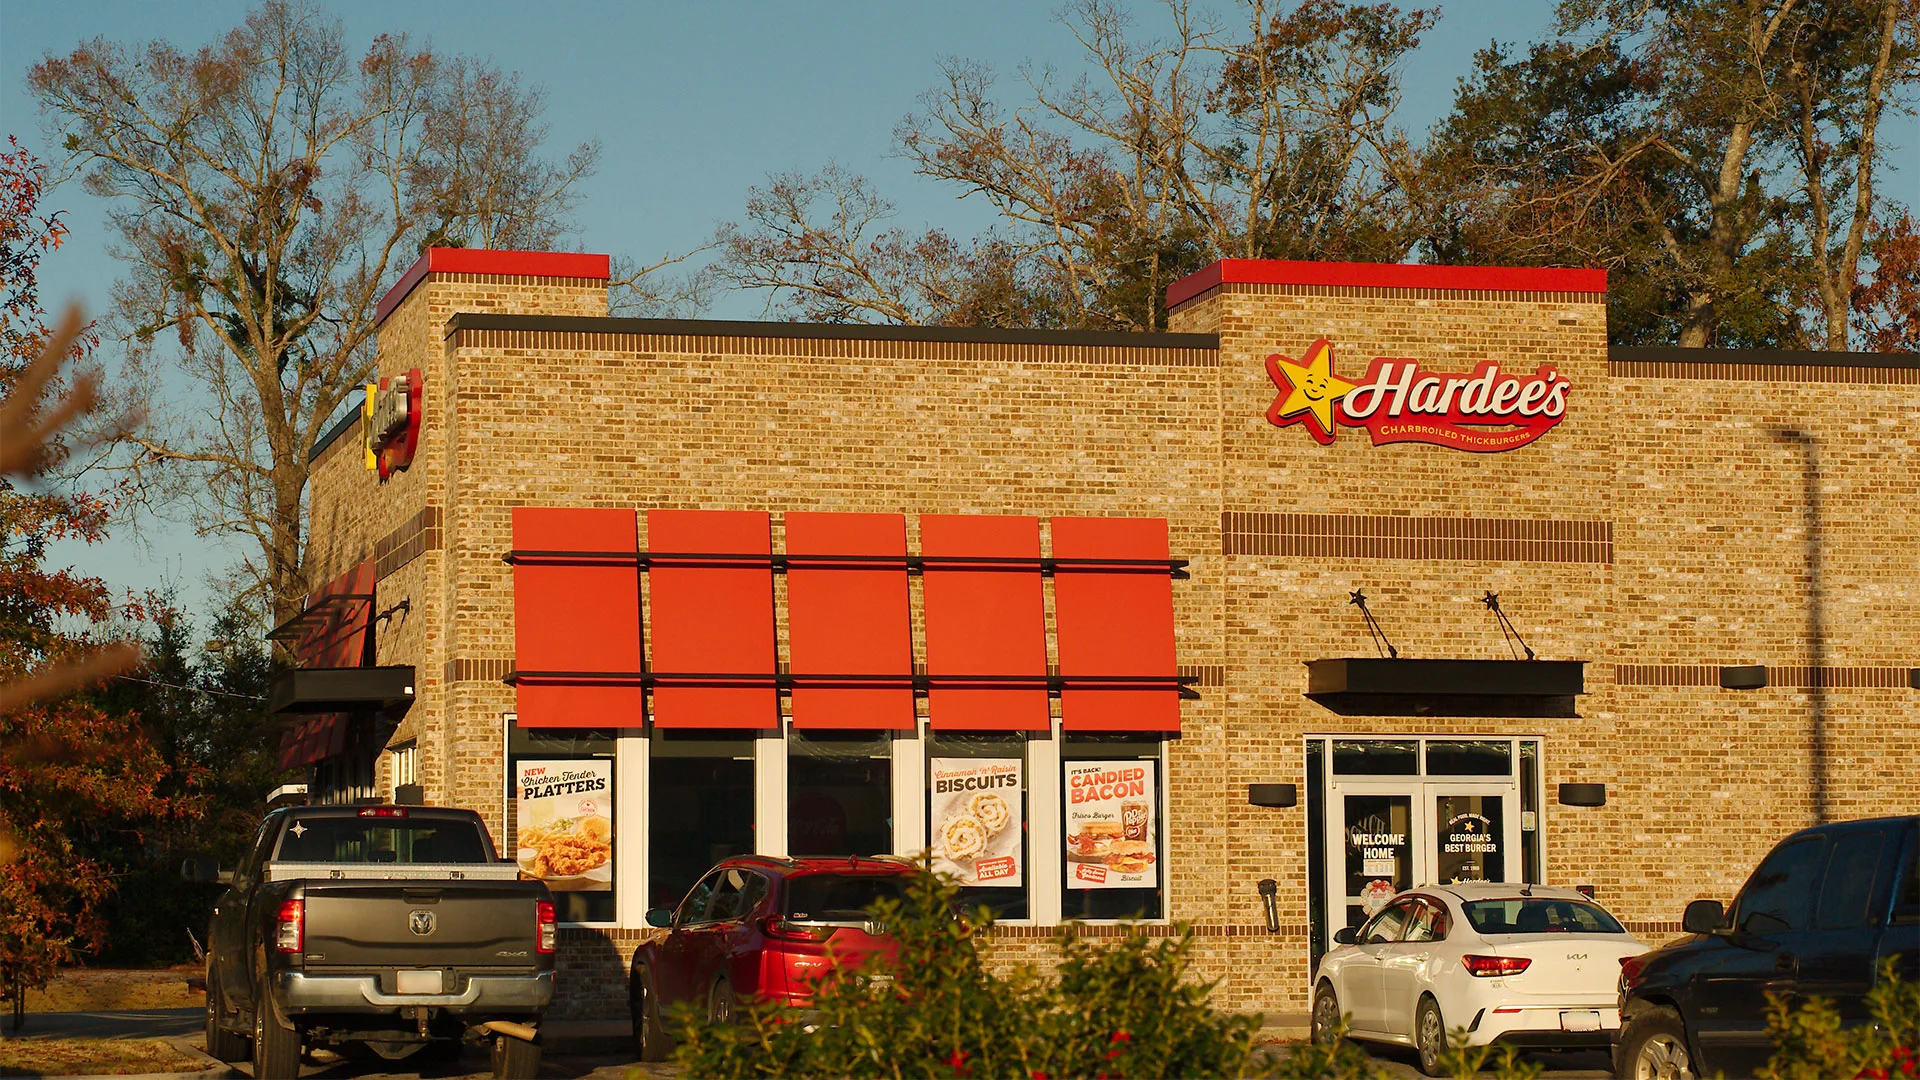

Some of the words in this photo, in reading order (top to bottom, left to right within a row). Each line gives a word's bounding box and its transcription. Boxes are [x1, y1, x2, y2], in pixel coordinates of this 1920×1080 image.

[1342, 363, 1571, 418] Hardee's
[1380, 425, 1458, 440] CHARBROILED
[1460, 432, 1531, 445] THICKBURGERS
[521, 775, 560, 787] Chicken
[562, 770, 596, 782] Tender
[524, 767, 546, 776] NEW
[934, 768, 977, 779] Cinnamon
[991, 765, 1017, 776] Raisin
[1070, 768, 1145, 788] CANDIED
[523, 777, 606, 800] PLATTERS
[936, 773, 1017, 794] BISCUITS
[1071, 780, 1144, 805] BACON
[1092, 812, 1115, 820] Burger
[1352, 833, 1405, 845] WELCOME
[1449, 833, 1491, 842] GEORGIA'S
[1363, 847, 1395, 859] HOME
[1444, 843, 1464, 852] BEST
[1465, 843, 1497, 852] BURGER
[980, 871, 993, 879] ALL
[994, 868, 1009, 877] DAY
